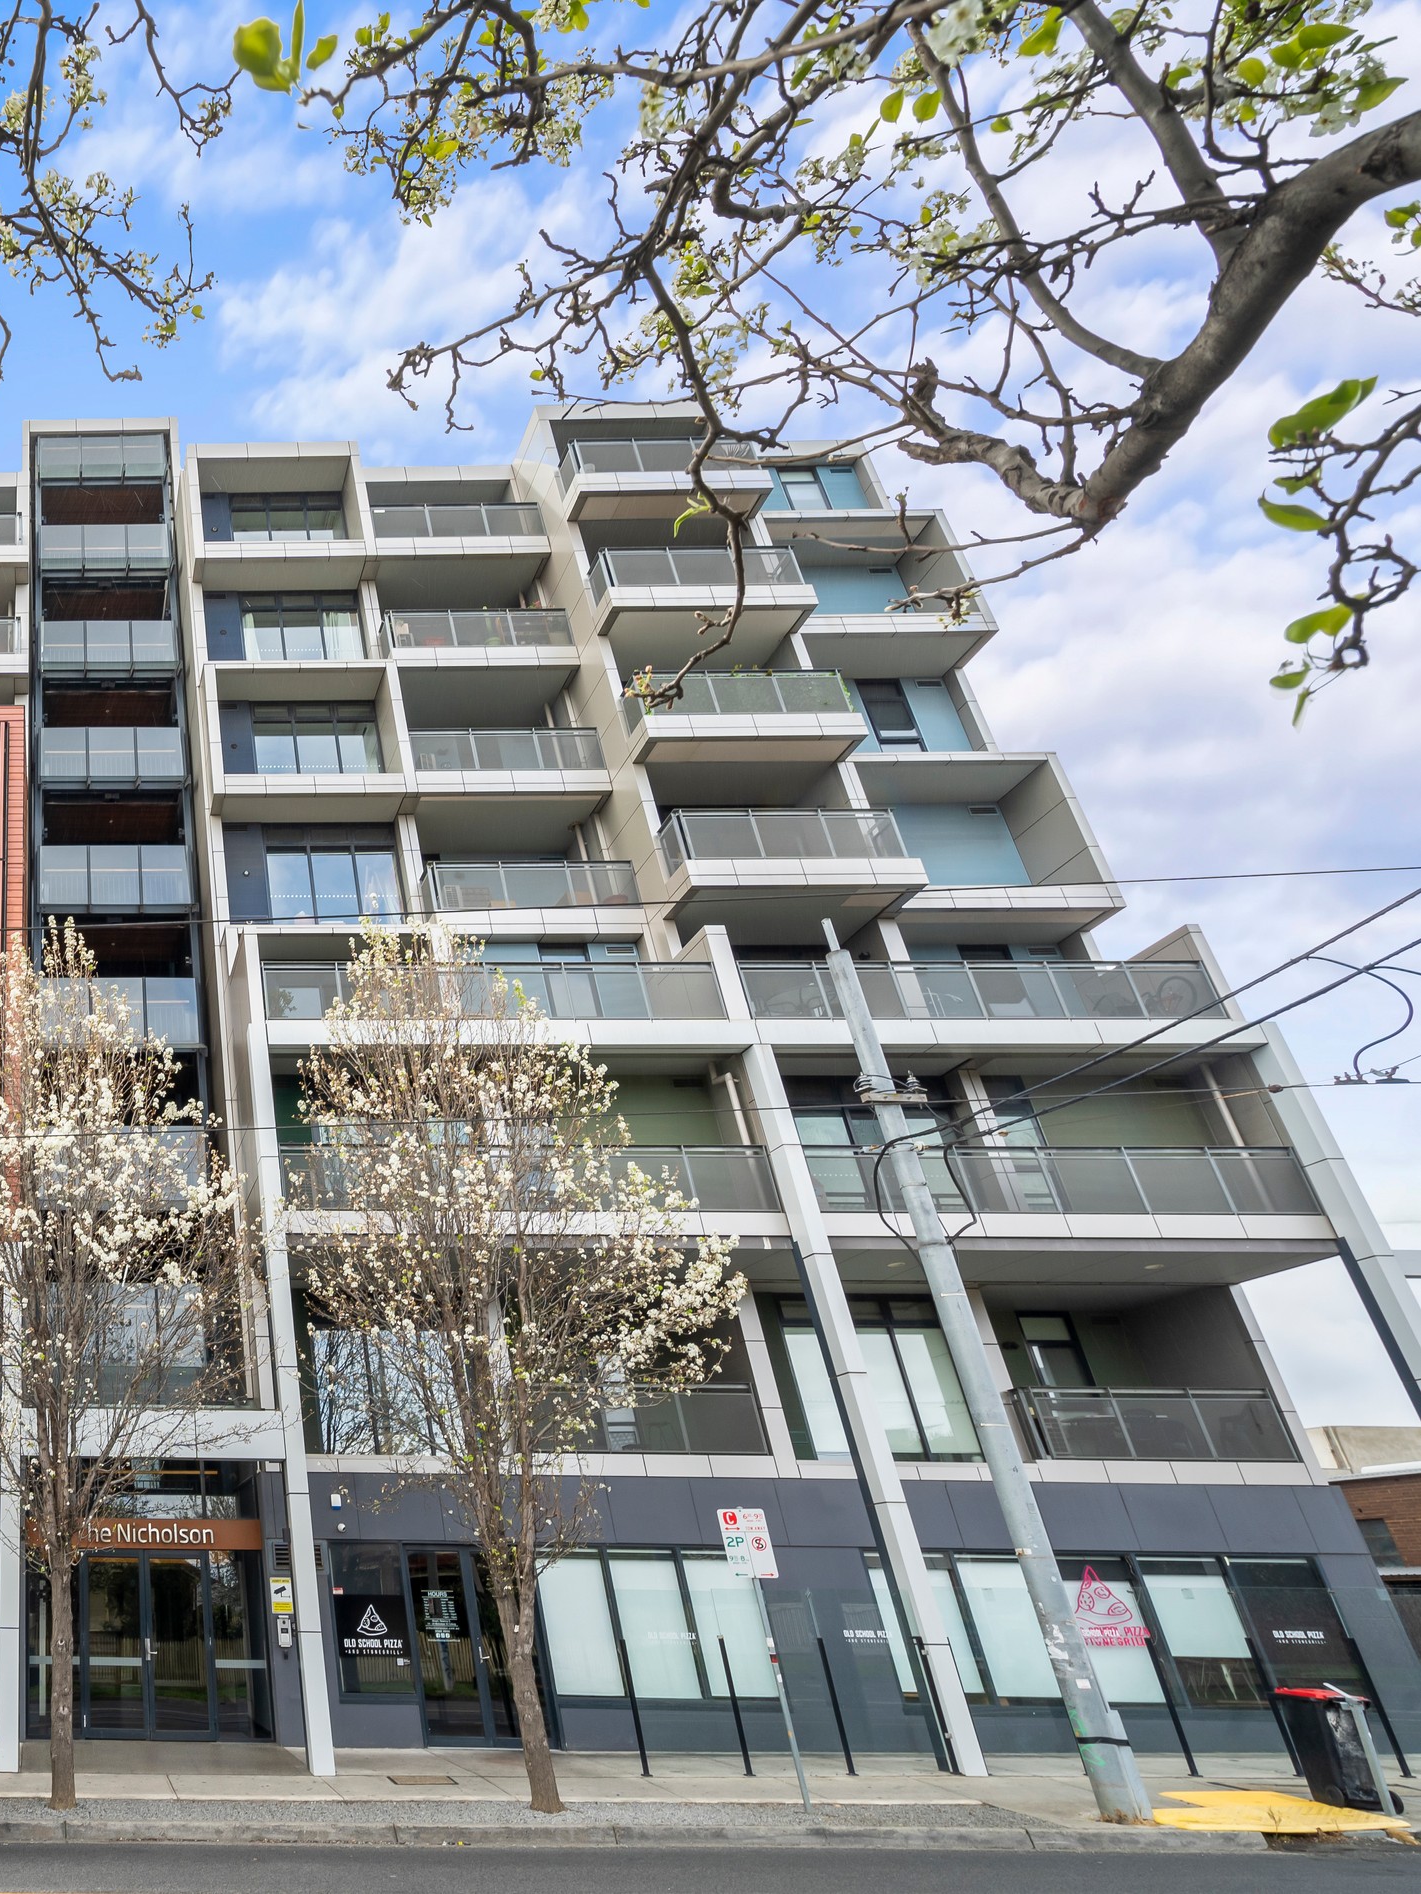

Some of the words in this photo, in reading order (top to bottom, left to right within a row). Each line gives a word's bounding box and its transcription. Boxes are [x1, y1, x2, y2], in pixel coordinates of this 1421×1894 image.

[85, 1522, 112, 1542] he
[117, 1523, 214, 1544] Nicholson
[726, 1536, 744, 1547] 2P
[344, 1639, 356, 1648] OLD
[358, 1639, 382, 1648] SCHOOL
[384, 1640, 402, 1648] PIZZA
